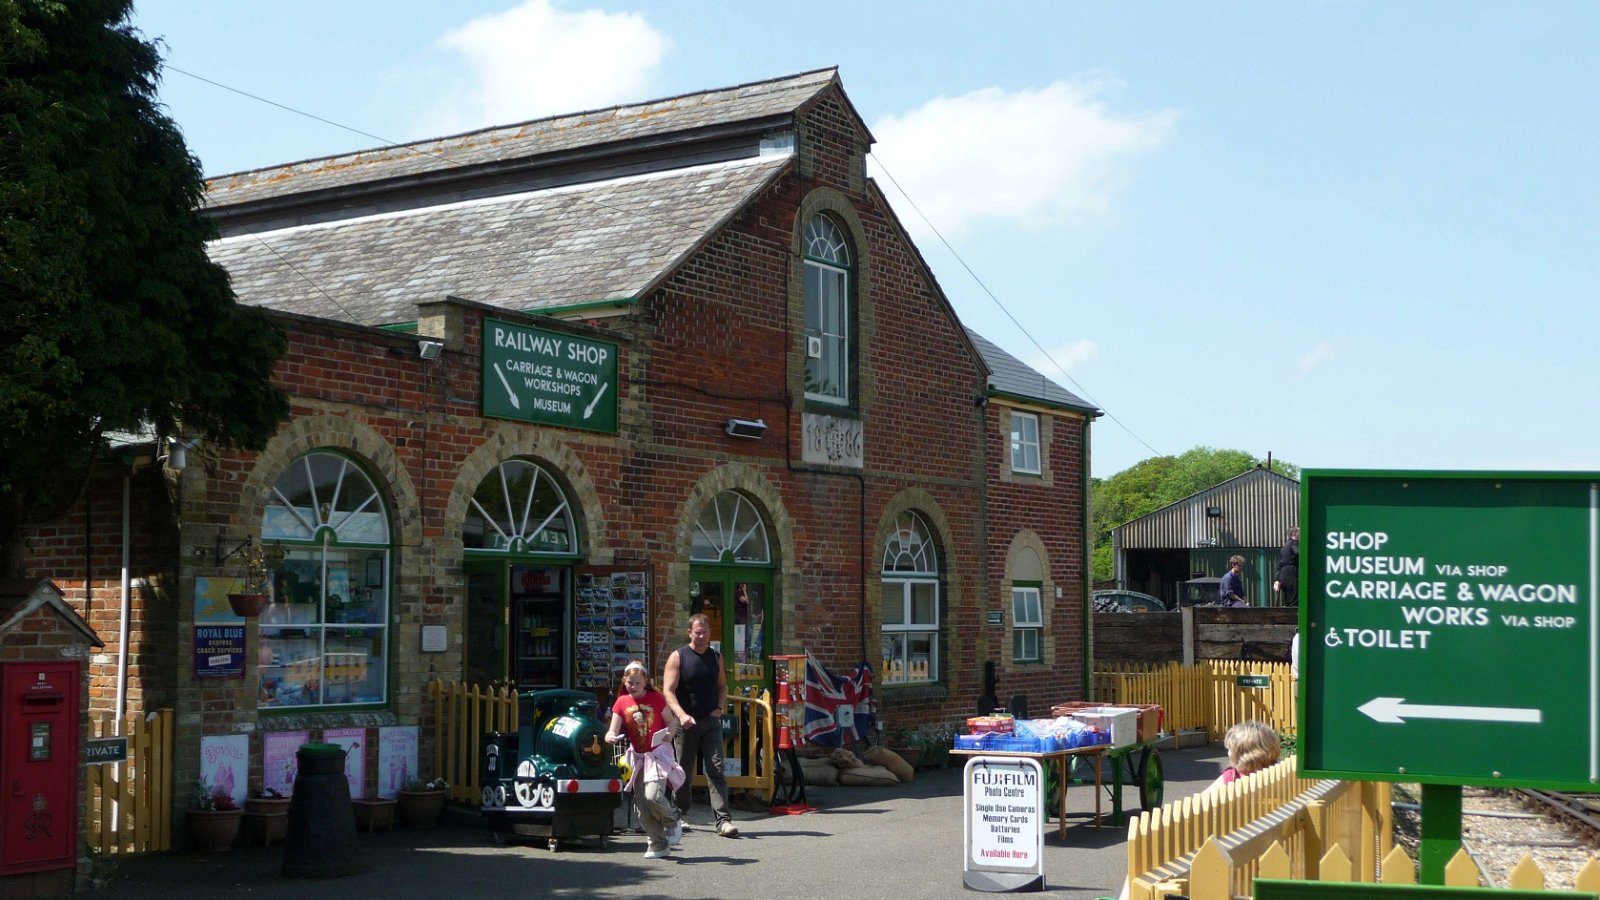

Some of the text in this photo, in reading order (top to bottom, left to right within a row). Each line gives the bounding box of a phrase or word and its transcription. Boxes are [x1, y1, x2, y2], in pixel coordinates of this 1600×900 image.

[495, 328, 608, 366] RAILWAY SHOP
[506, 359, 598, 385] CARRIAGE & WAGON
[524, 377, 581, 396] WORKSHOPS
[533, 398, 571, 414] MUSEUM
[1210, 537, 1217, 545] 2
[1325, 532, 1388, 550] SHOP
[1325, 556, 1508, 577] MUSEUM VIA SHOP
[1325, 580, 1576, 603] CARRIAGE & WAGON
[1401, 607, 1575, 628] WORKS VIA SHOP
[196, 628, 244, 639] ROYAL BLUE
[1344, 629, 1431, 649] TOILET
[196, 646, 243, 654] coach services
[86, 745, 120, 756] RIVATE
[974, 772, 1035, 786] FUJIFILM
[984, 786, 1025, 798] Photo Centre
[975, 803, 1035, 814] Single Use Cameras
[983, 814, 1029, 824] Memory Cards
[990, 824, 1020, 834] Batteries
[997, 835, 1014, 844] Films
[980, 848, 1028, 859] Available Here
